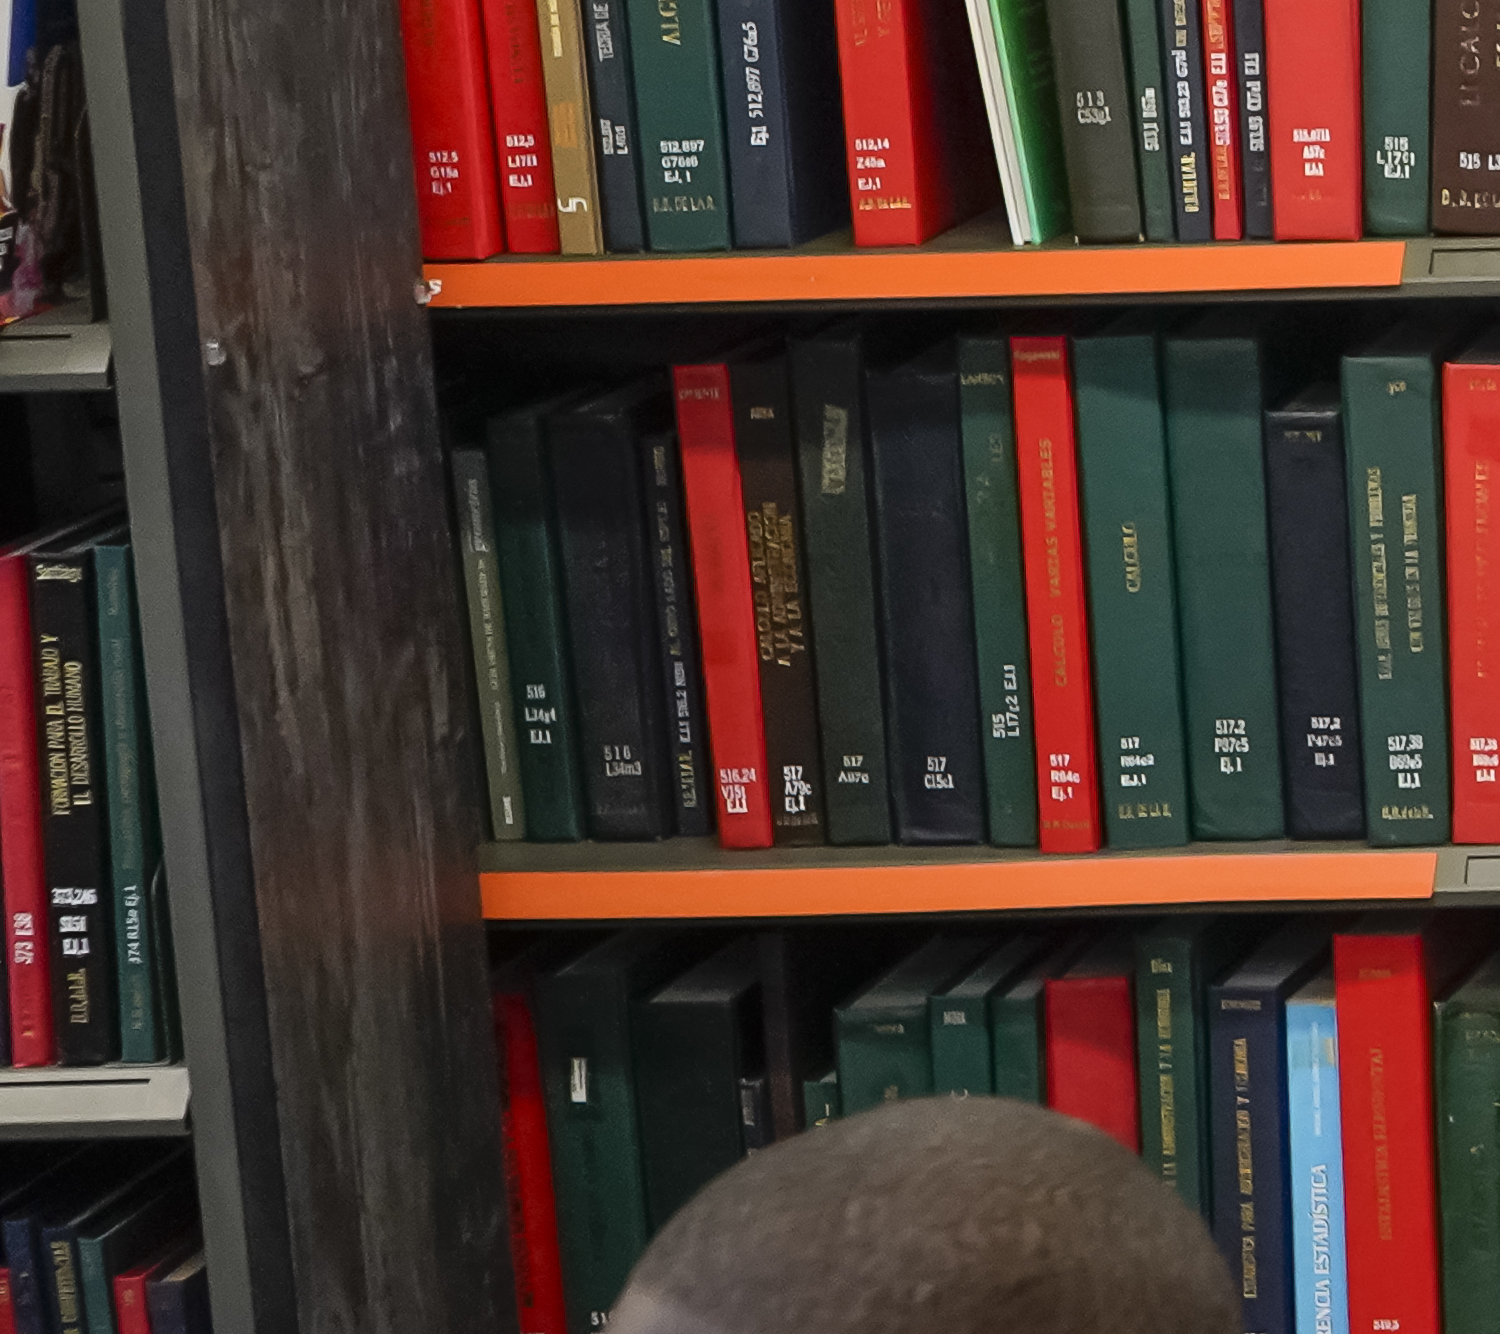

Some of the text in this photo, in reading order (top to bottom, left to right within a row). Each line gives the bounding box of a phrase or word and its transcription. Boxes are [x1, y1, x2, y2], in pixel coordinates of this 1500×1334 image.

[592, 3, 610, 19] DE
[1038, 439, 1058, 532] VARIABLES
[1043, 534, 1064, 598] VARIAS
[42, 648, 62, 697] TRABAJO
[63, 661, 85, 712] HUMANO
[48, 719, 65, 749] PARA
[49, 752, 72, 815] FORMACION
[1308, 1164, 1332, 1275] ESTADÍSTICA
